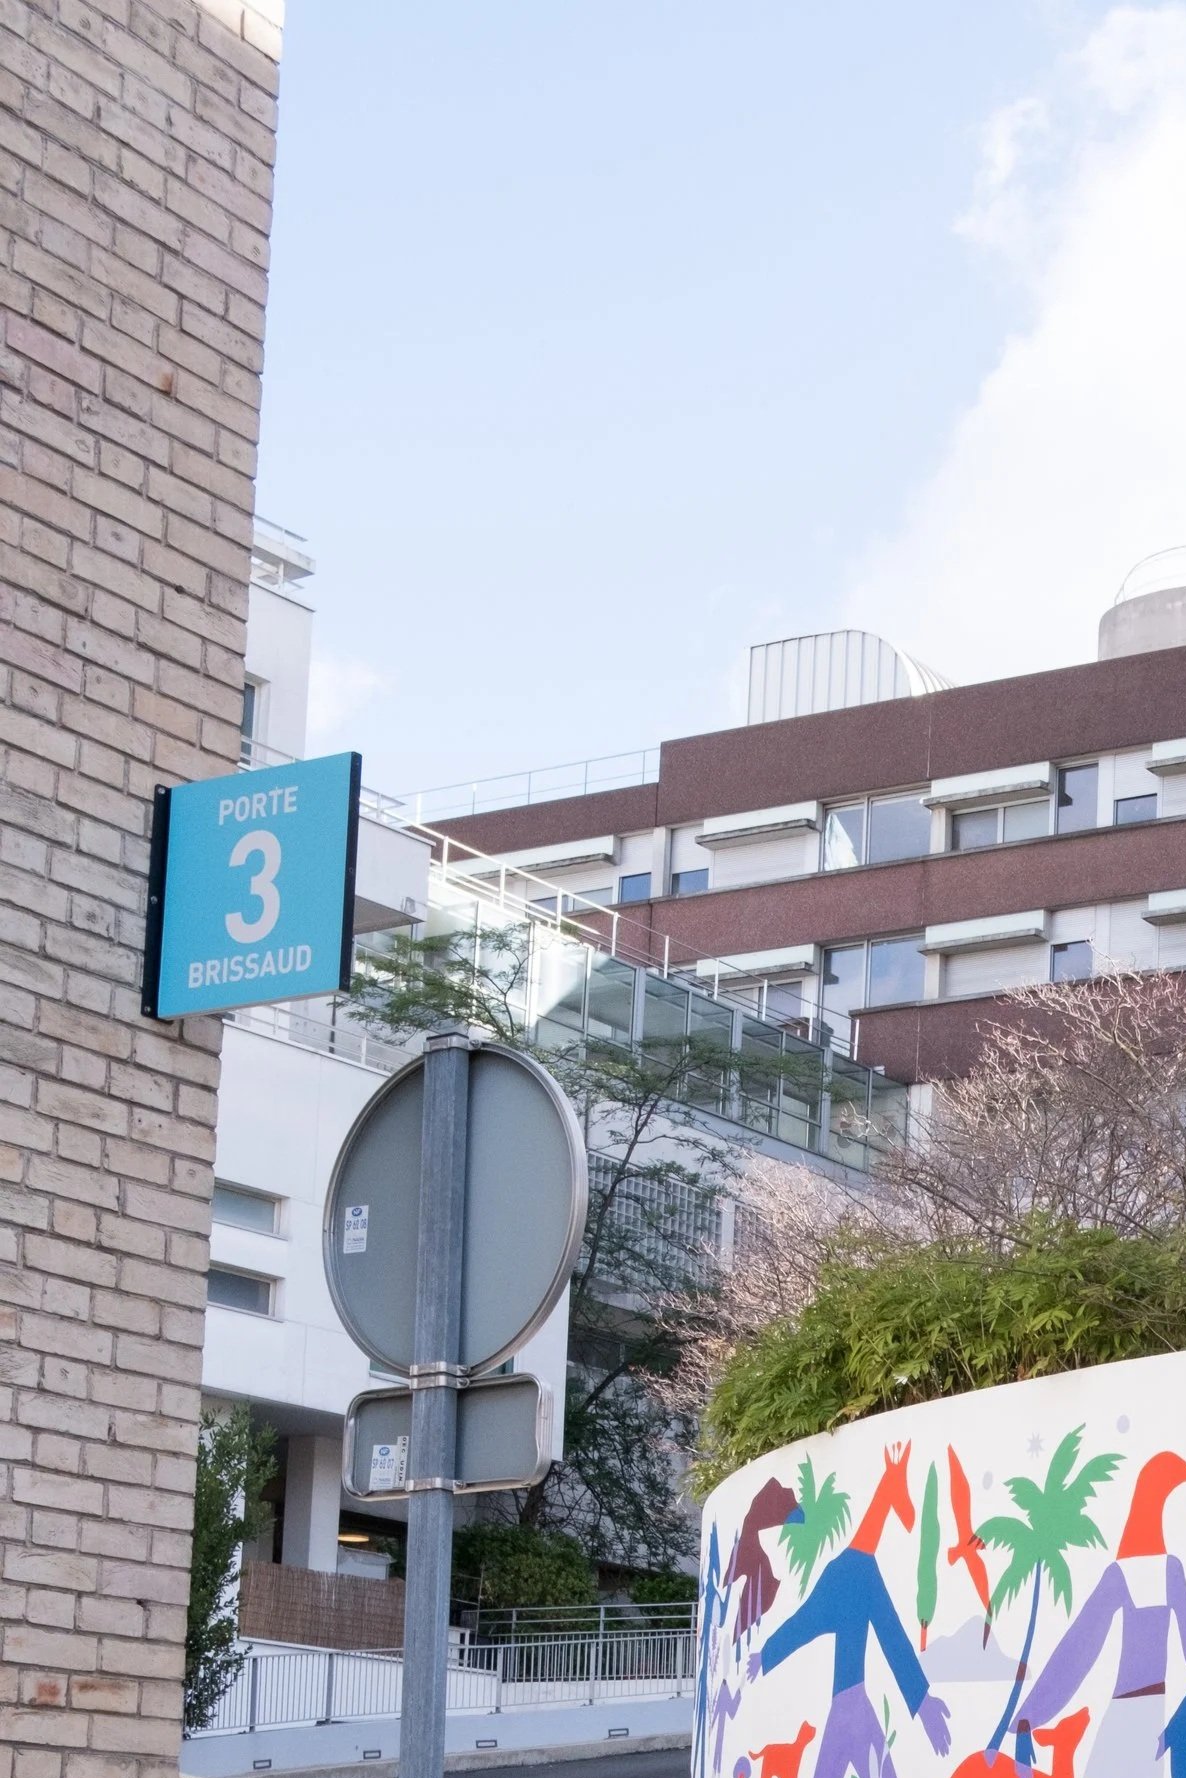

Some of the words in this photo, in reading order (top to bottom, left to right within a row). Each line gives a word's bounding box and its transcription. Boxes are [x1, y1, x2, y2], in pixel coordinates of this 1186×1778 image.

[218, 786, 299, 826] PORTE
[225, 829, 282, 944] 3
[188, 944, 312, 989] BRISSAUD
